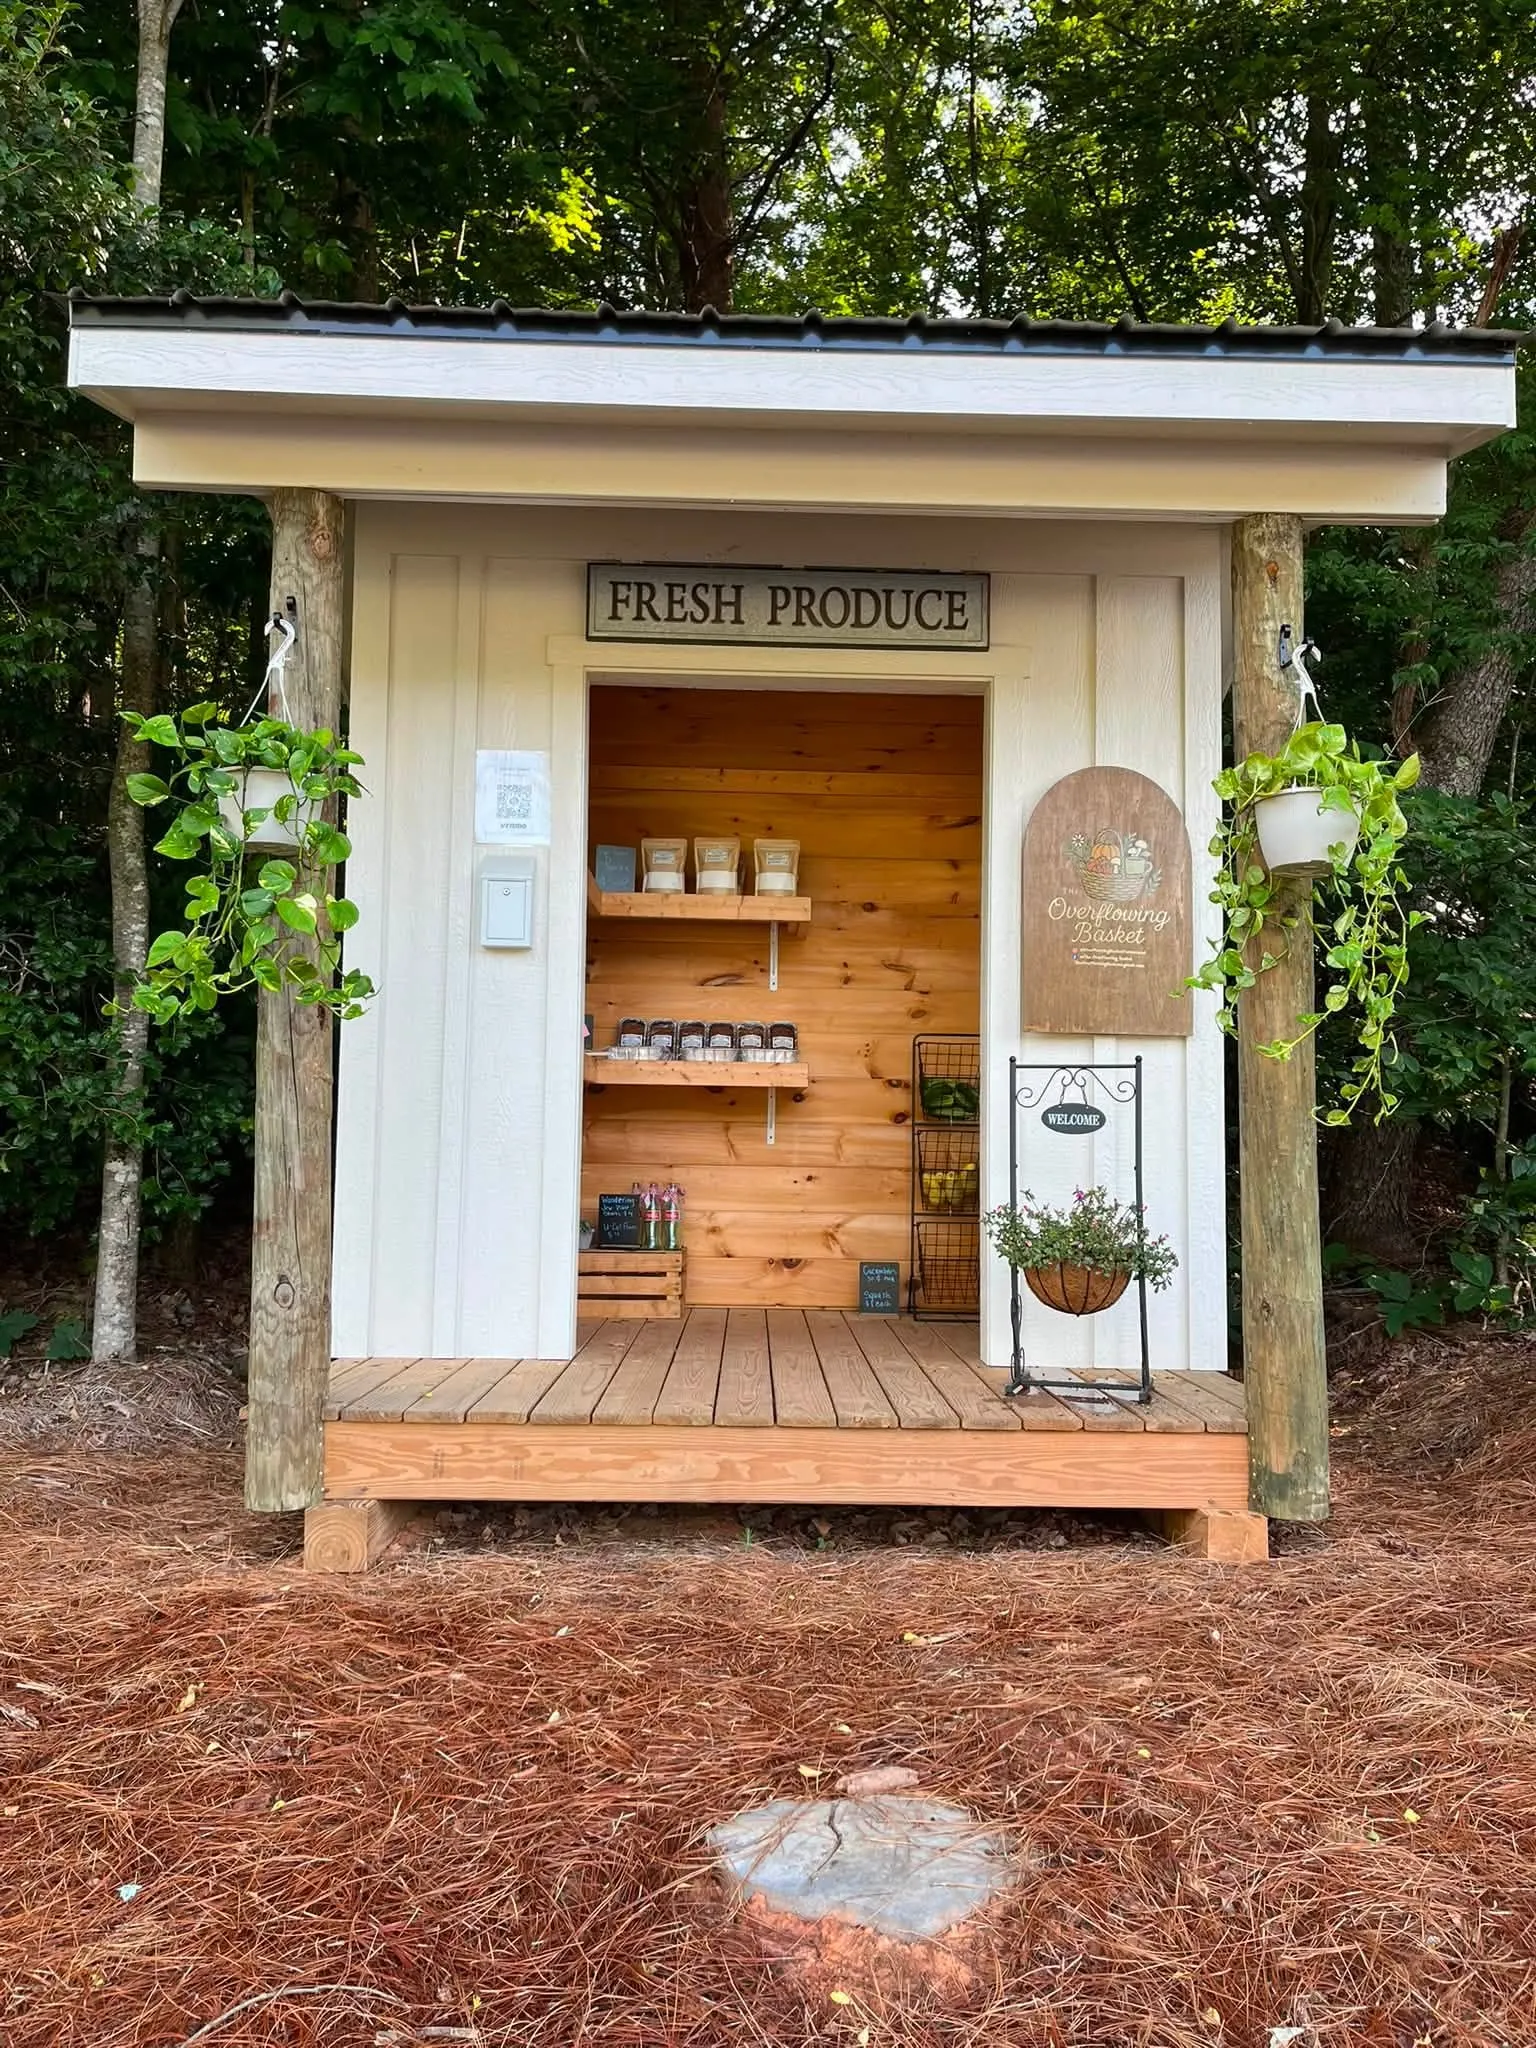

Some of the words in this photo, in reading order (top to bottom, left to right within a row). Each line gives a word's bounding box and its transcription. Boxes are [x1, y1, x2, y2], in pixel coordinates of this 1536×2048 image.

[607, 580, 745, 625] FRESH
[767, 584, 969, 631] PRODUCE
[1048, 897, 1171, 931] Overflowing
[1071, 921, 1146, 944] Basket
[1047, 1113, 1100, 1126] WELCOME
